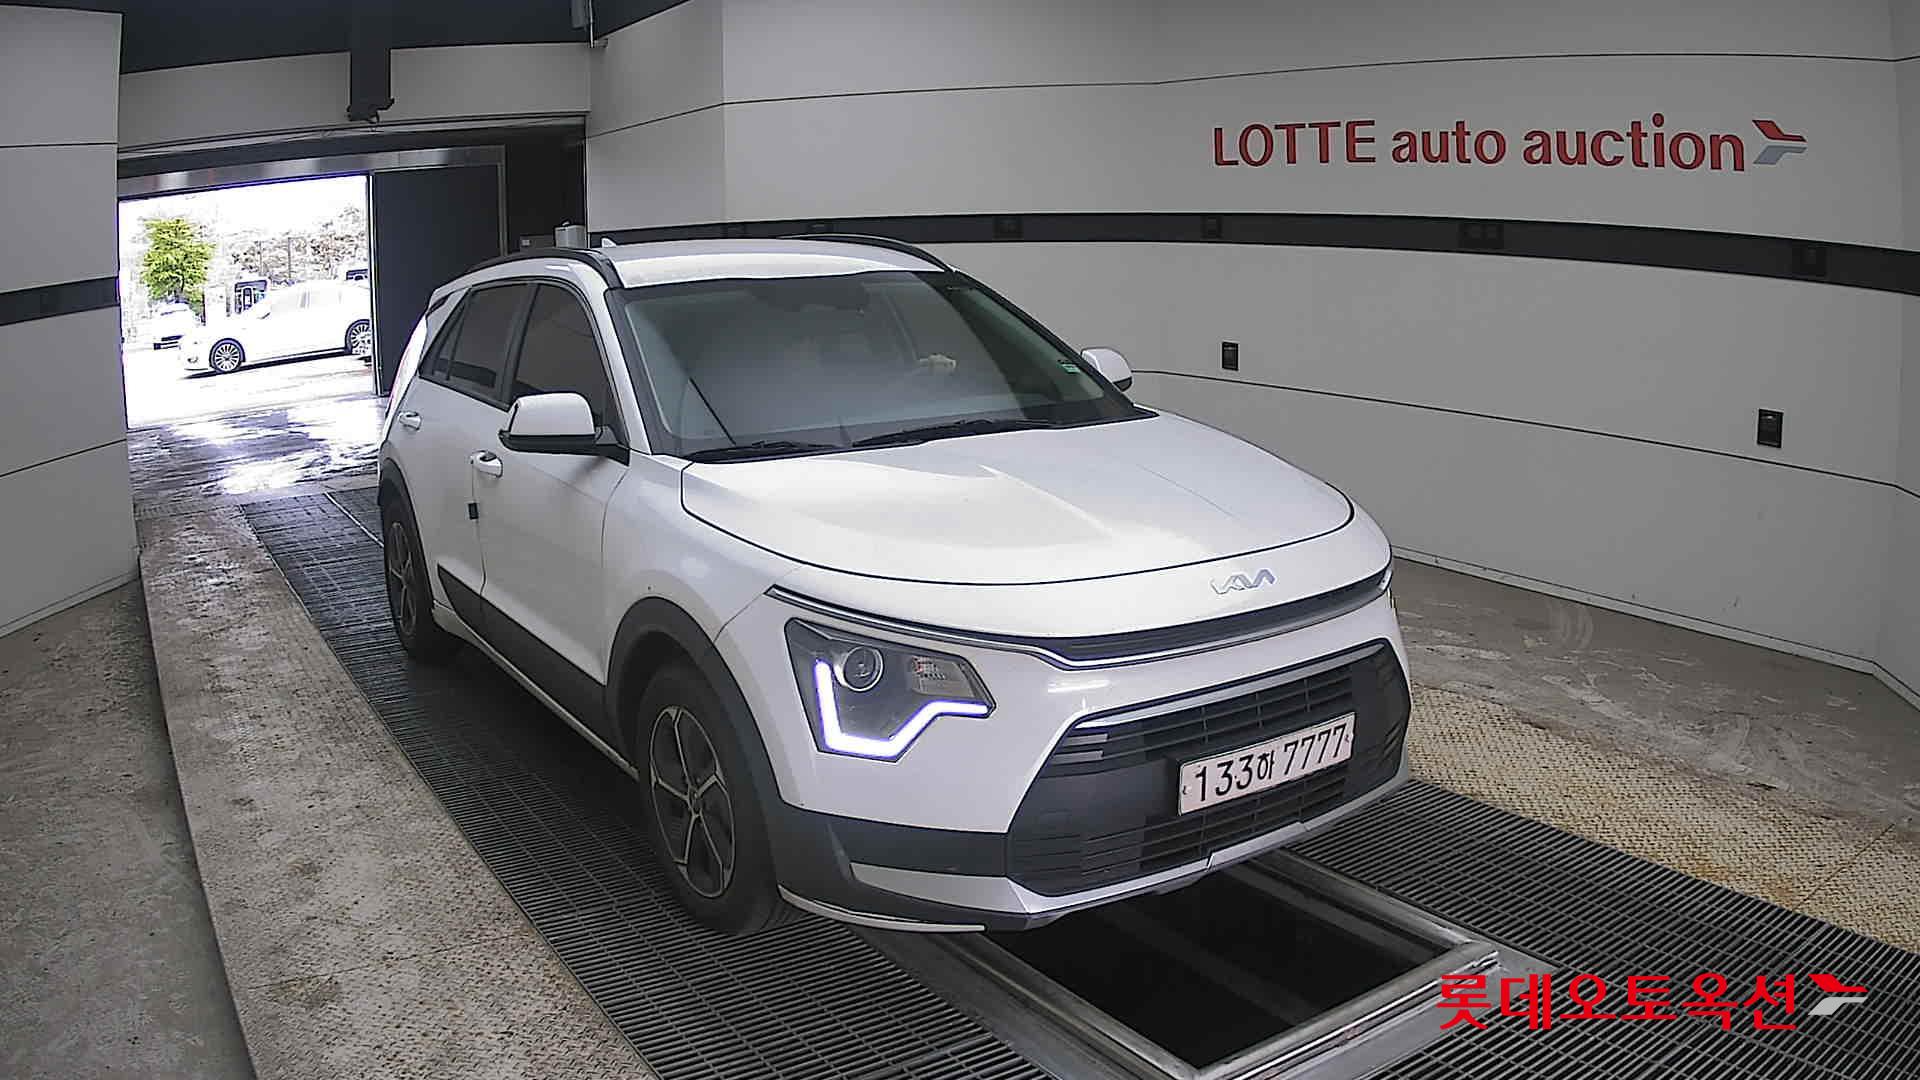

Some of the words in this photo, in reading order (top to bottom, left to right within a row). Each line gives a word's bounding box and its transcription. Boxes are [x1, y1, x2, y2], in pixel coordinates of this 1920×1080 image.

[1213, 119, 1376, 167] LOTTE
[1391, 120, 1507, 165] auto
[1523, 112, 1745, 172] auction
[1209, 568, 1276, 595] KIA
[1195, 750, 1275, 802] 133하
[1284, 723, 1348, 776] 7777
